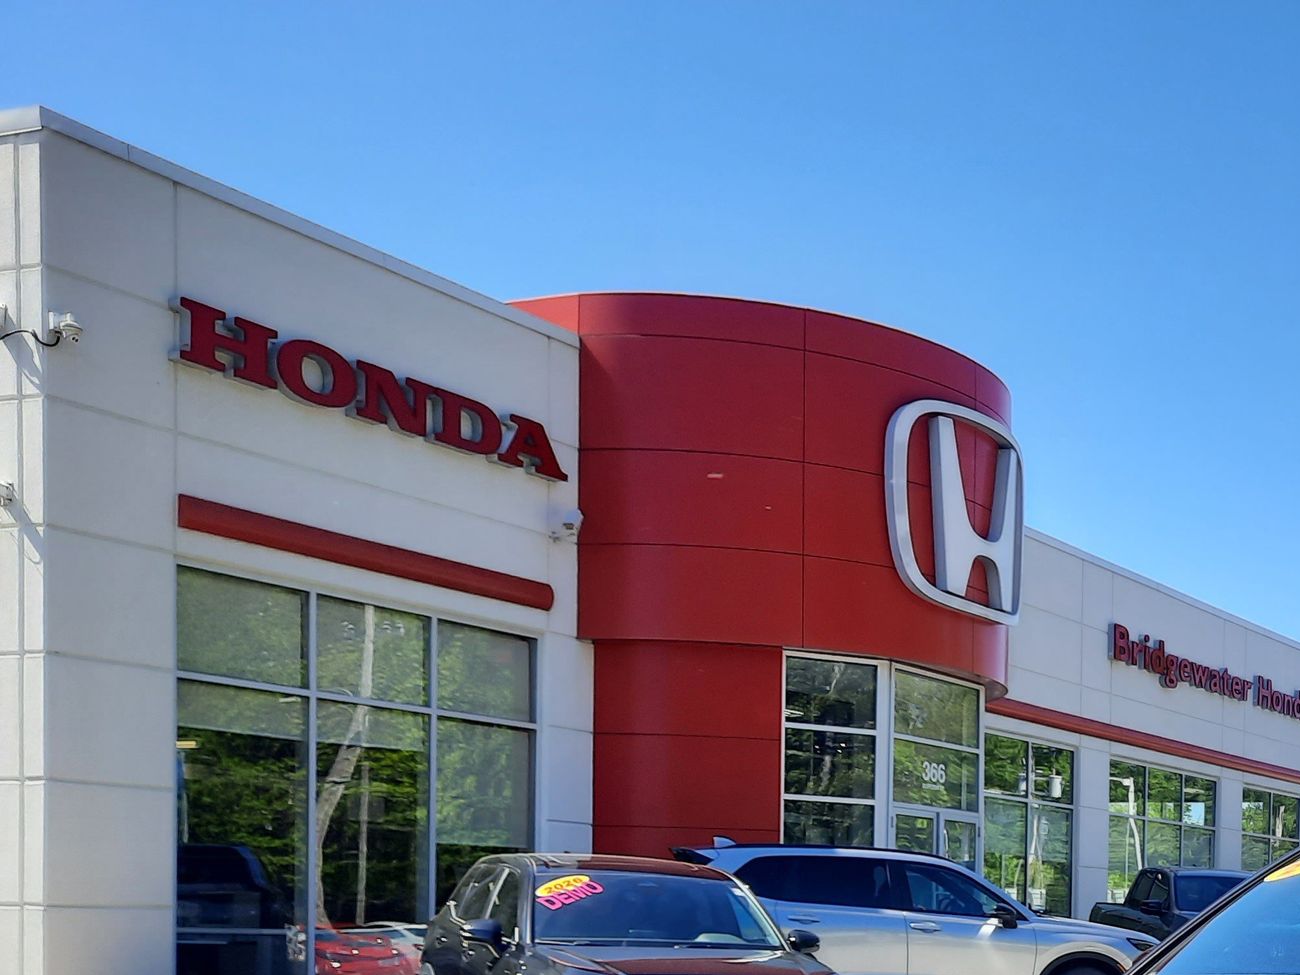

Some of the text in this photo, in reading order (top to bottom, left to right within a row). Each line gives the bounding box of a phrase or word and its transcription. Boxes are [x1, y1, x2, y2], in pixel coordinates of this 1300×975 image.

[176, 296, 568, 482] HONDA
[1112, 623, 1253, 700] Bridgewater
[922, 761, 946, 783] 366
[535, 881, 604, 910] DEMO
